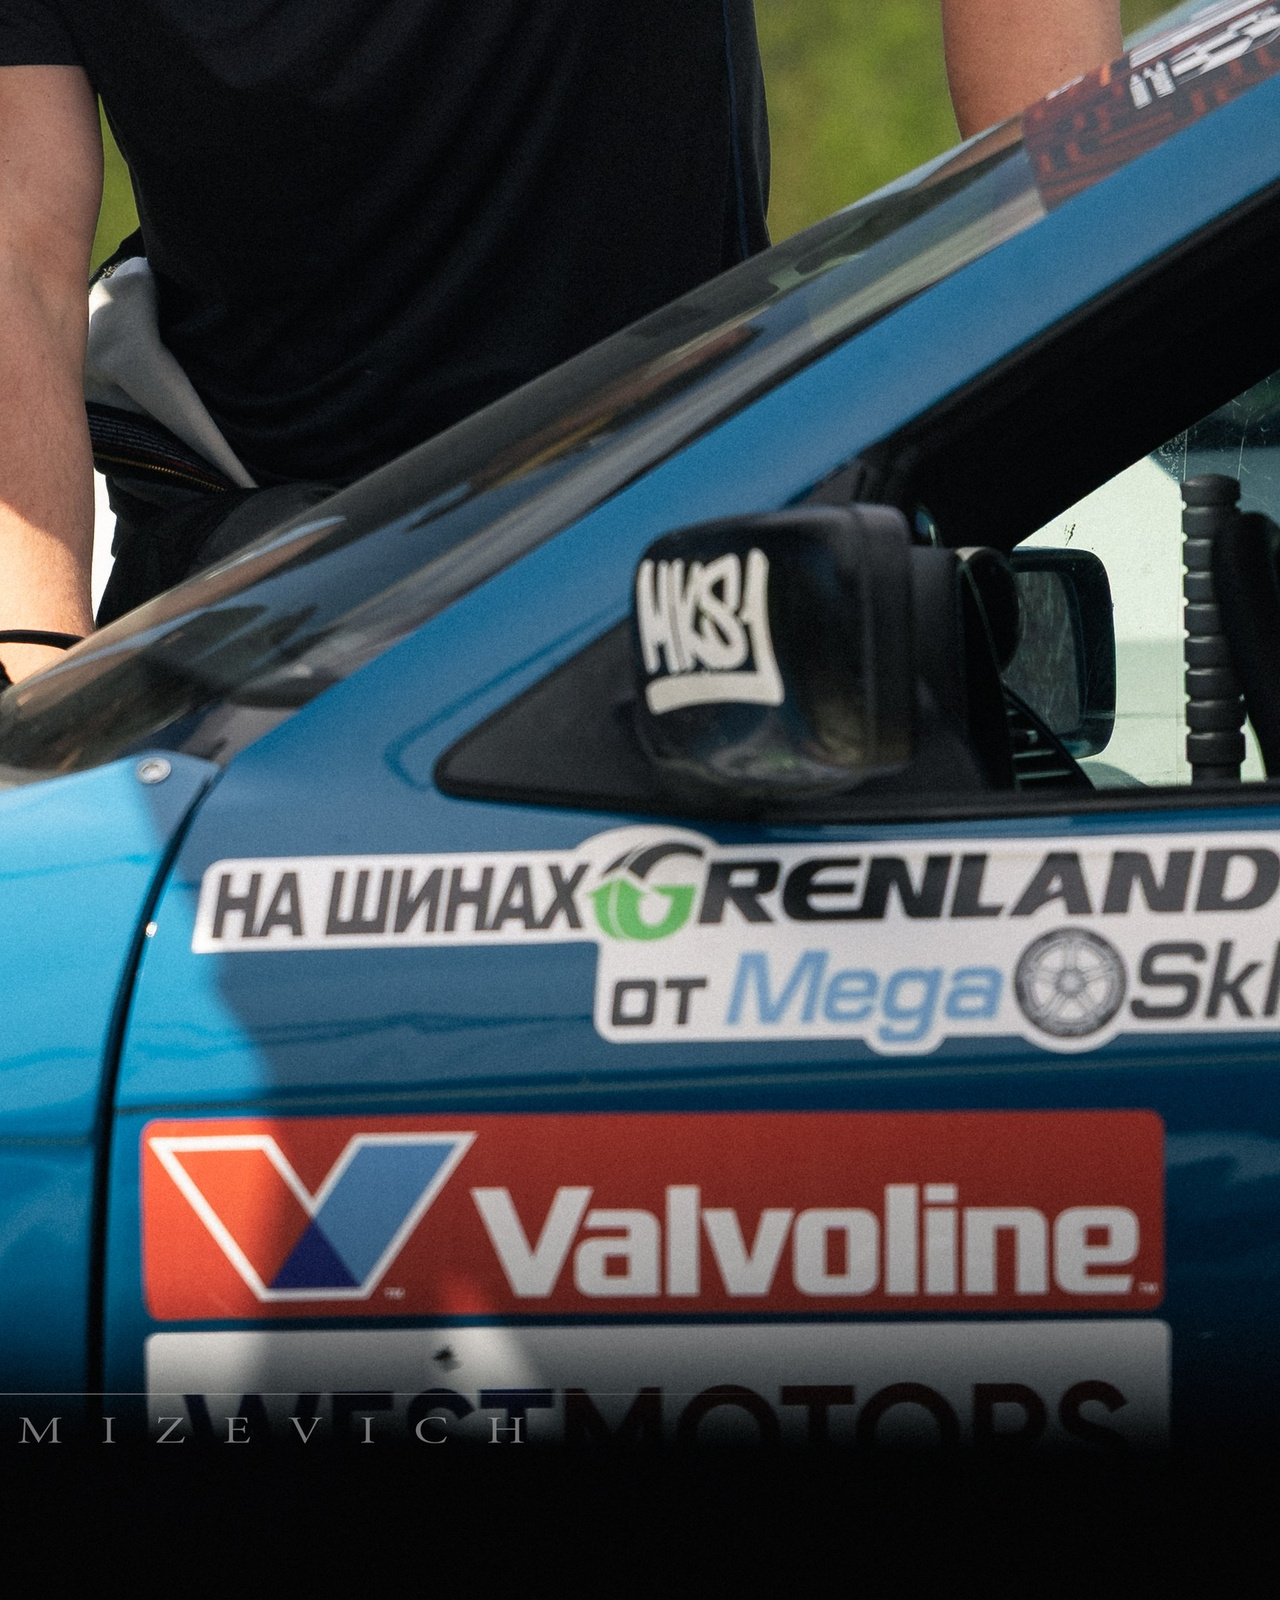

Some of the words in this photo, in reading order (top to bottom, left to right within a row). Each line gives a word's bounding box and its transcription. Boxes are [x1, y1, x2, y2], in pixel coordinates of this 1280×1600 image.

[212, 871, 305, 939] НА
[325, 862, 591, 936] ШИНАХ
[470, 1182, 1142, 1300] Valvoline
